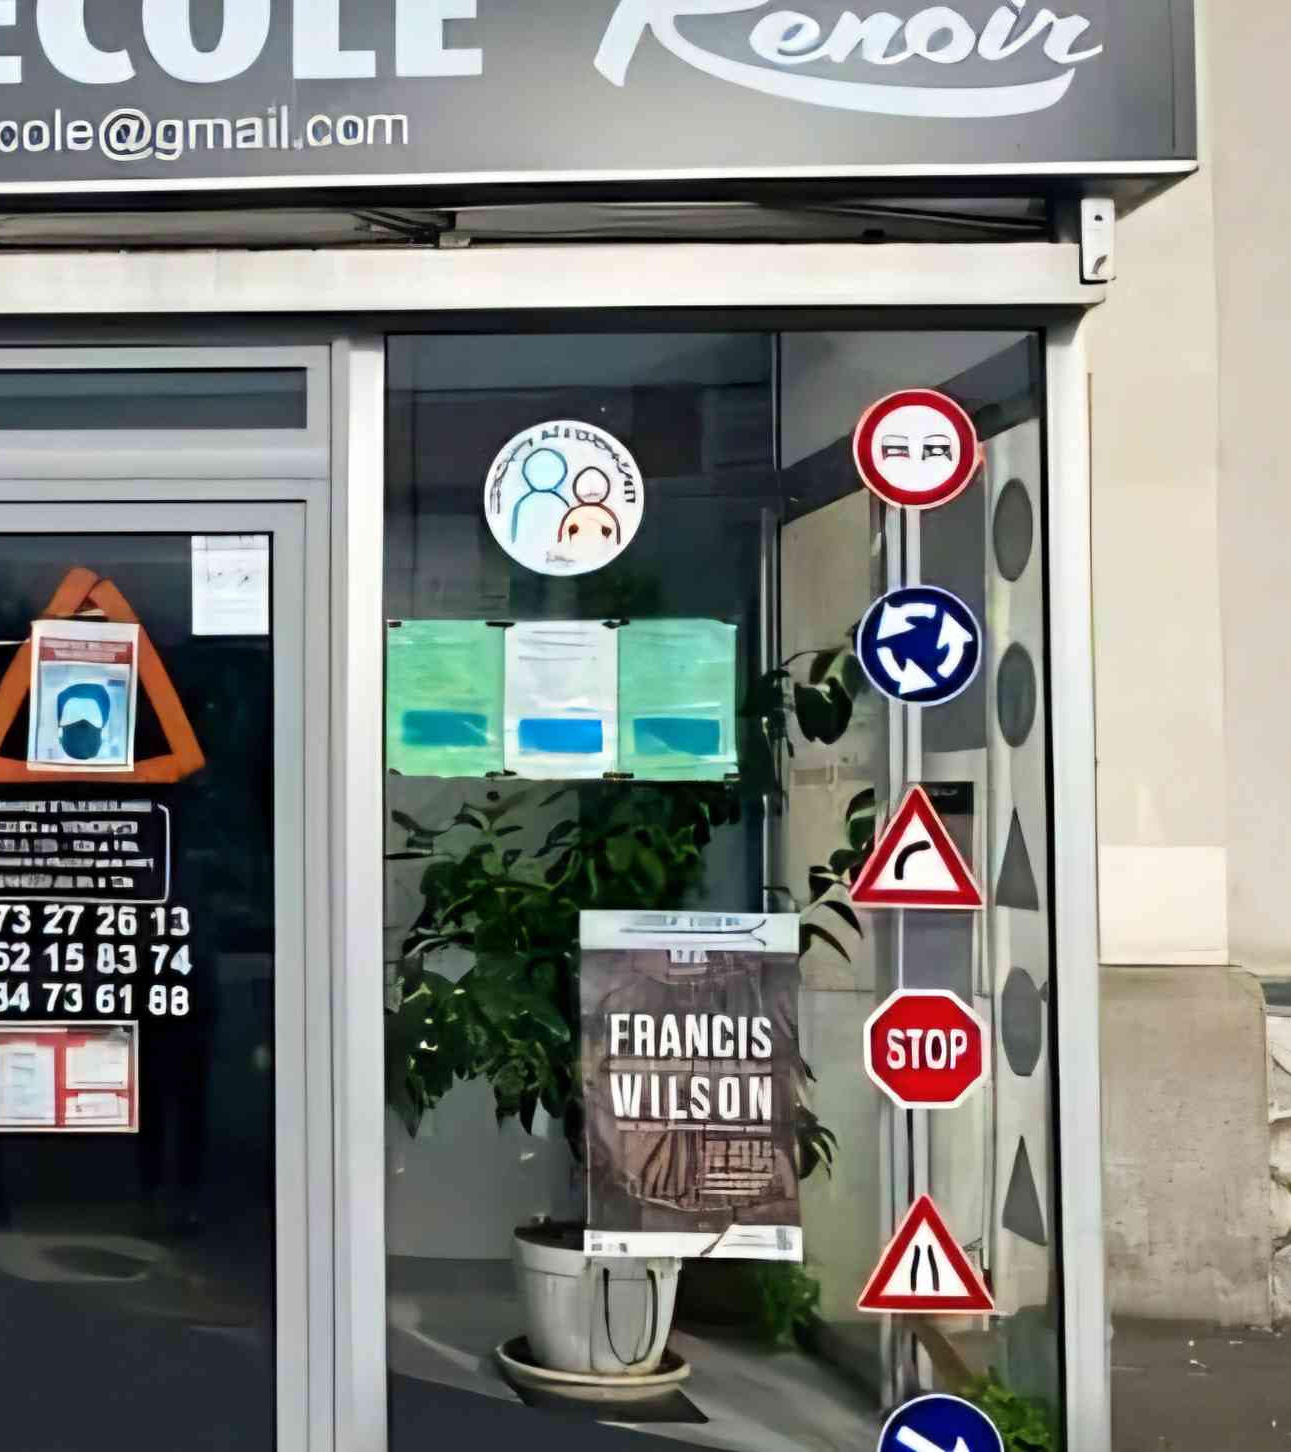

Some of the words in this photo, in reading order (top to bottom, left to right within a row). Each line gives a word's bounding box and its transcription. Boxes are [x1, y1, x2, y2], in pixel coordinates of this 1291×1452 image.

[42, 903, 85, 936] 27
[95, 905, 138, 936] 26
[150, 906, 190, 937] 13
[44, 942, 85, 972] 15
[96, 942, 138, 975] 83
[150, 943, 192, 975] 74
[42, 982, 83, 1013] 73
[95, 983, 133, 1015] 61
[148, 984, 190, 1016] 88
[610, 1012, 773, 1060] FRANCIS
[886, 1028, 968, 1070] STOP
[609, 1067, 772, 1121] WILSON
